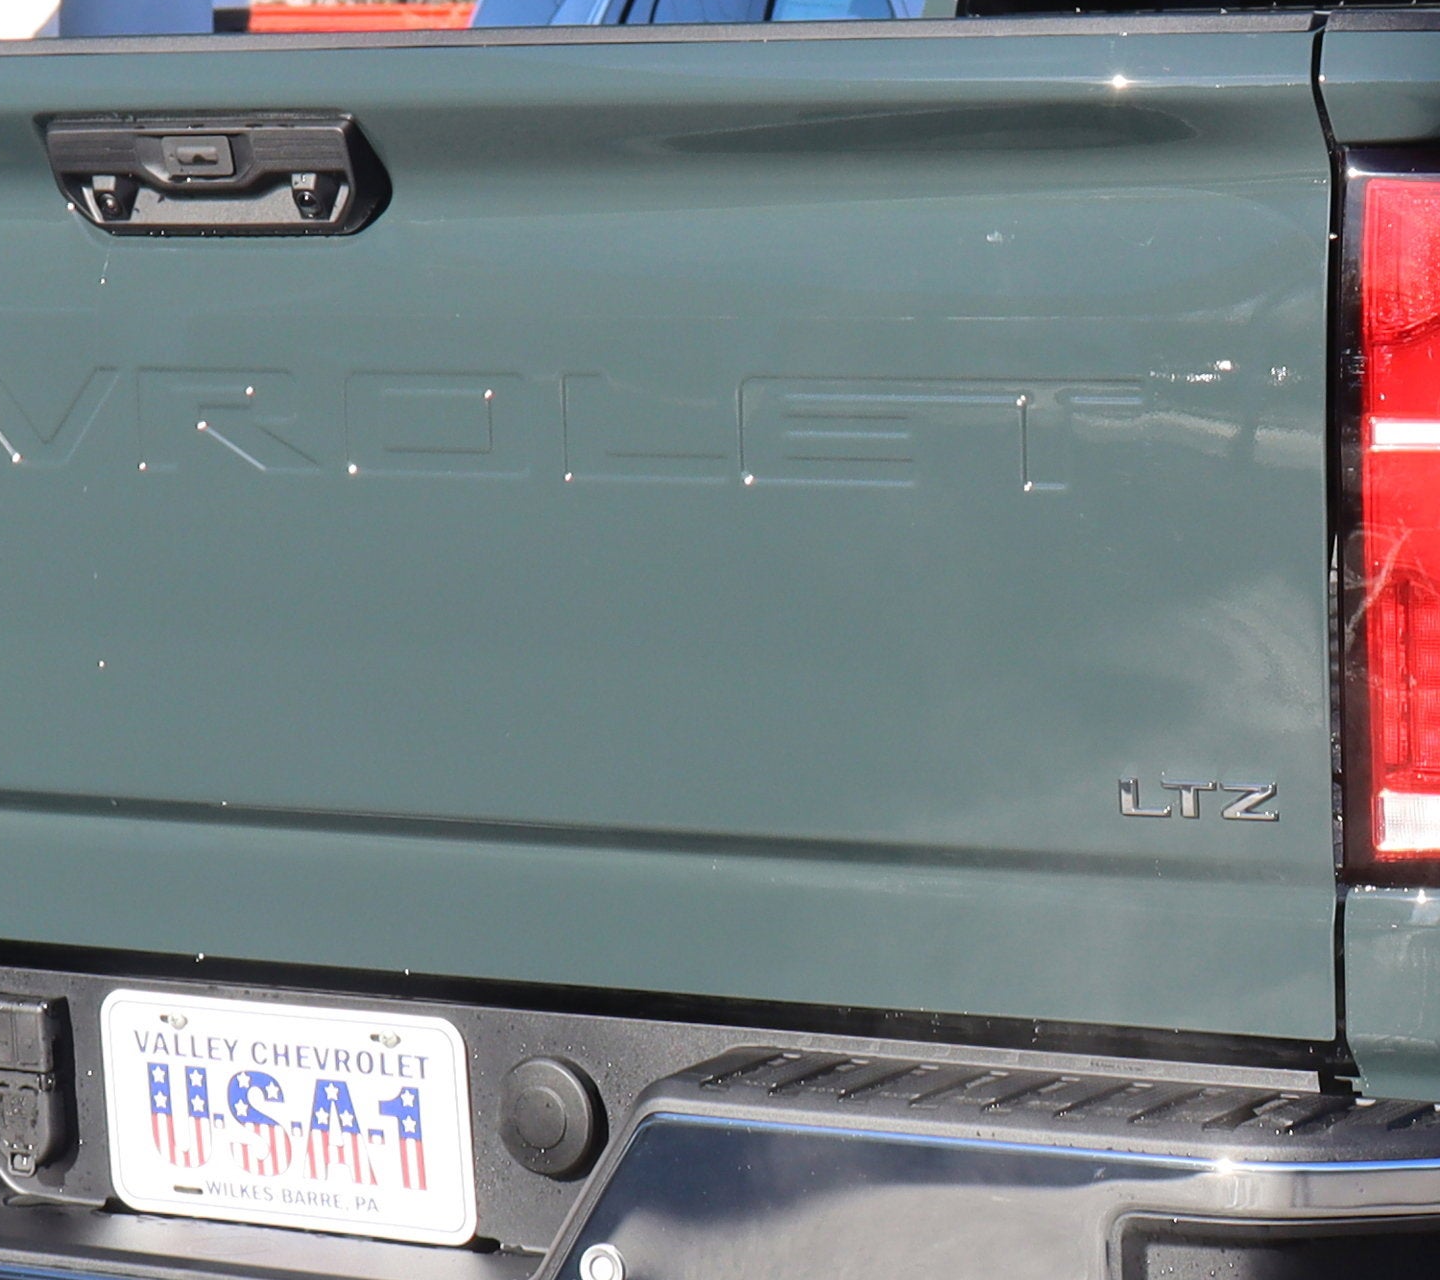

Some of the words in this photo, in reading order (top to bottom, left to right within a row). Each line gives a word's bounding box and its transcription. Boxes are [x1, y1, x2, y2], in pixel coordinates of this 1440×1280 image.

[1118, 776, 1280, 822] LTZ
[133, 1029, 239, 1063] VALLEY
[250, 1041, 430, 1081] CHEVROLET
[205, 1180, 274, 1203] WILKES
[355, 1195, 380, 1214] PA
